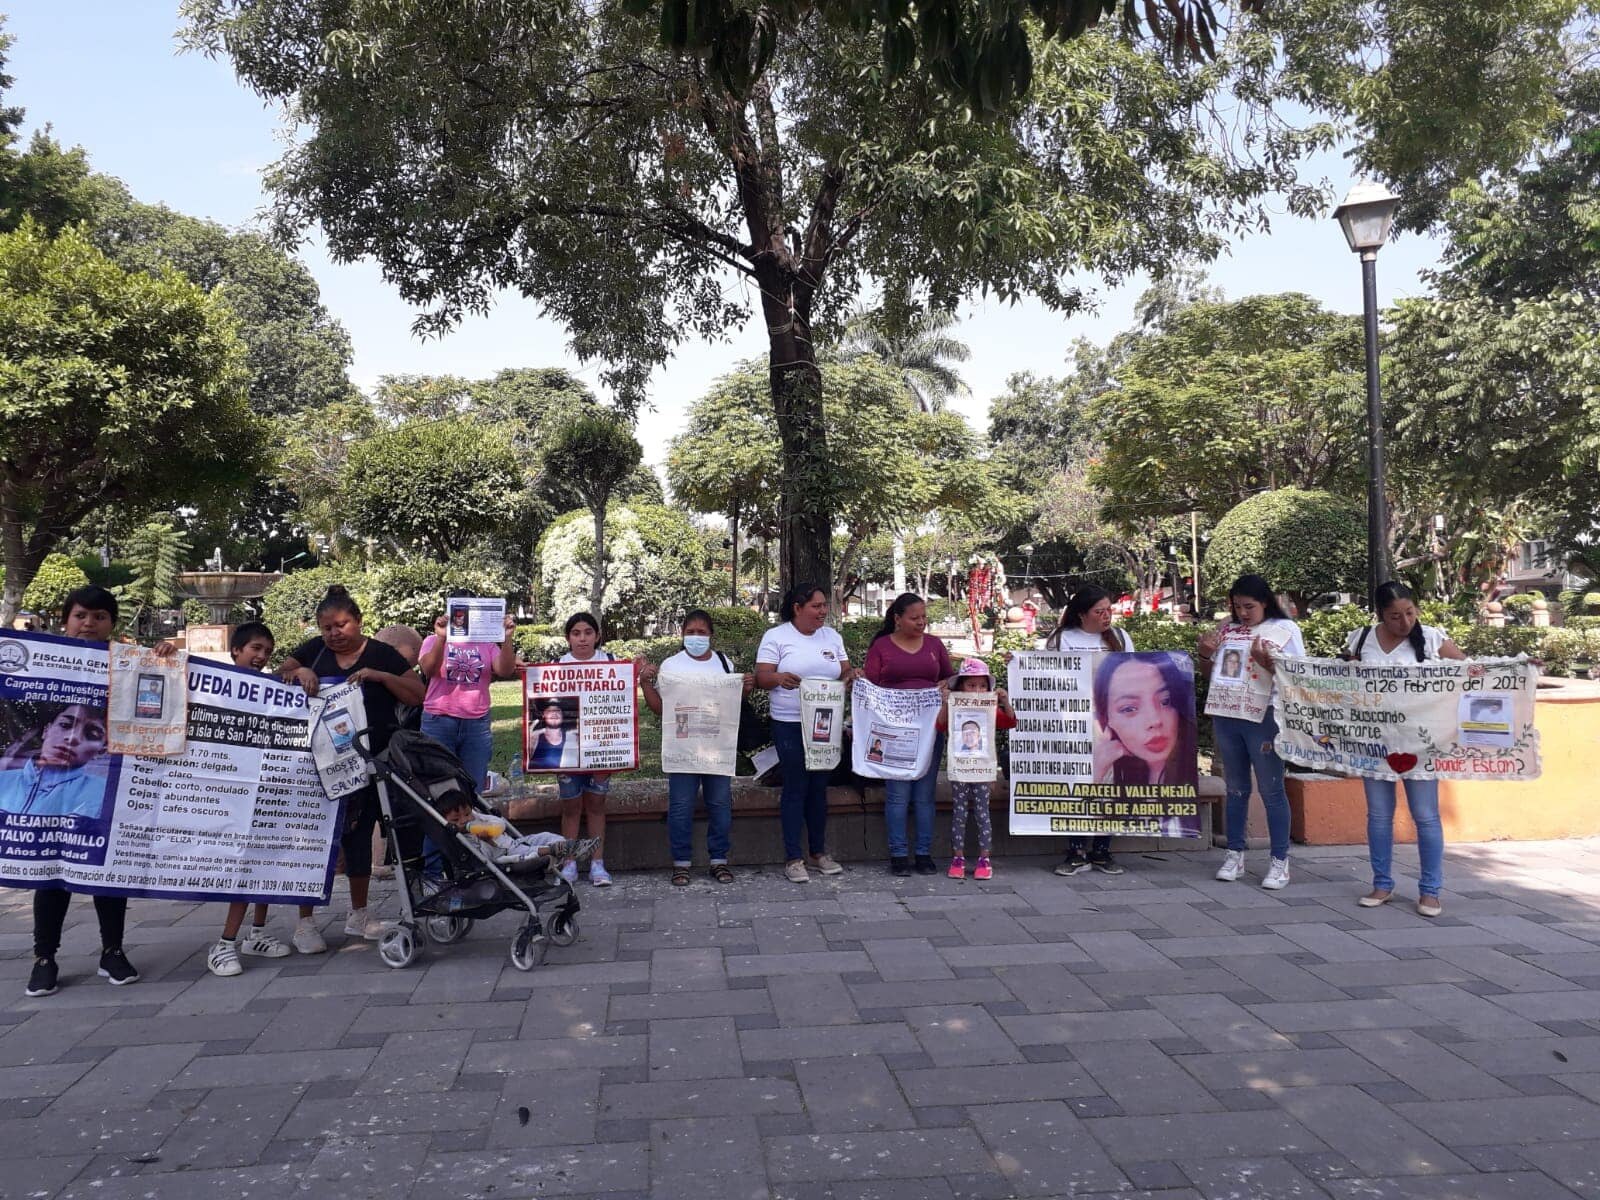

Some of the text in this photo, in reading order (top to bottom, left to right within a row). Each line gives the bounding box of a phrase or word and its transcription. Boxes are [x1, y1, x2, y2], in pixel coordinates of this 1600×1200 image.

[33, 653, 83, 665] FISCALÍA
[1019, 654, 1081, 670] MI BÚSQUEDA NO SE
[542, 668, 616, 681] AYUDAME A
[1284, 659, 1306, 674] Luis
[1313, 663, 1350, 678] Manuel
[1355, 666, 1409, 679] Barrientos
[5, 677, 59, 691] Carpeta de
[188, 671, 260, 702] UEDA DE
[533, 680, 625, 693] ENCONTRARLO
[1023, 675, 1078, 691] DETENDRÁ HASTA
[1404, 679, 1455, 693] Febrero
[1462, 678, 1484, 691] del
[1492, 676, 1527, 691] 2019
[25, 691, 102, 706] para localizar a:
[589, 695, 625, 704] OSCAR IVAN
[1060, 699, 1068, 712] MI
[1069, 699, 1090, 712] DOLOR
[191, 706, 269, 730] última vez el 10 de
[583, 705, 631, 716] DIAZ GONZALEZ
[1292, 702, 1344, 720] Seguimos
[1350, 708, 1406, 723] Buscando
[196, 723, 212, 737] isla
[214, 726, 225, 739] de
[227, 728, 244, 742] San
[1043, 719, 1063, 733] HASTA
[1064, 720, 1077, 733] VER
[1078, 720, 1087, 734] TU
[1010, 738, 1092, 754] ROSTRO Y MI INDIGNACIÓN
[189, 748, 231, 760] 1.70 mts.
[262, 752, 292, 762] Nariz:
[135, 754, 238, 772] Complexión: delgada
[261, 763, 290, 773] Boca:
[1011, 761, 1092, 775] HASTA OBTENER JUSTICIA
[1350, 755, 1380, 770] Duele
[133, 764, 192, 779] Tez: claro
[131, 776, 172, 789] Cabello:
[205, 784, 249, 796] ondulado
[259, 775, 296, 785] Labios:
[129, 788, 221, 804] Cejas: abundantes
[257, 785, 293, 796] Orejas:
[1015, 783, 1196, 798] ALONDRA ARACELI VALLE MEJÍA
[127, 800, 229, 817] Ojos: oscuros
[255, 796, 320, 809] Frente: chica
[1015, 799, 1197, 816] DESAPARECÍ EL 6 DE ABRIL 2023
[5, 814, 75, 829] ALEJANDRO
[251, 819, 319, 831] Cara: ovalada
[1051, 818, 1069, 831] EN
[38, 831, 105, 847] JARAMILLO
[5, 846, 89, 860] Años de edad
[1, 865, 20, 875] datos
[27, 864, 64, 877] cualquier
[106, 872, 116, 882] de
[117, 874, 127, 882] su
[159, 876, 177, 886] llama
[178, 877, 186, 886] al
[187, 877, 200, 886] 444
[201, 877, 214, 888] 204
[215, 878, 232, 889] 0413
[237, 879, 248, 888] 444
[295, 881, 306, 892] 752
